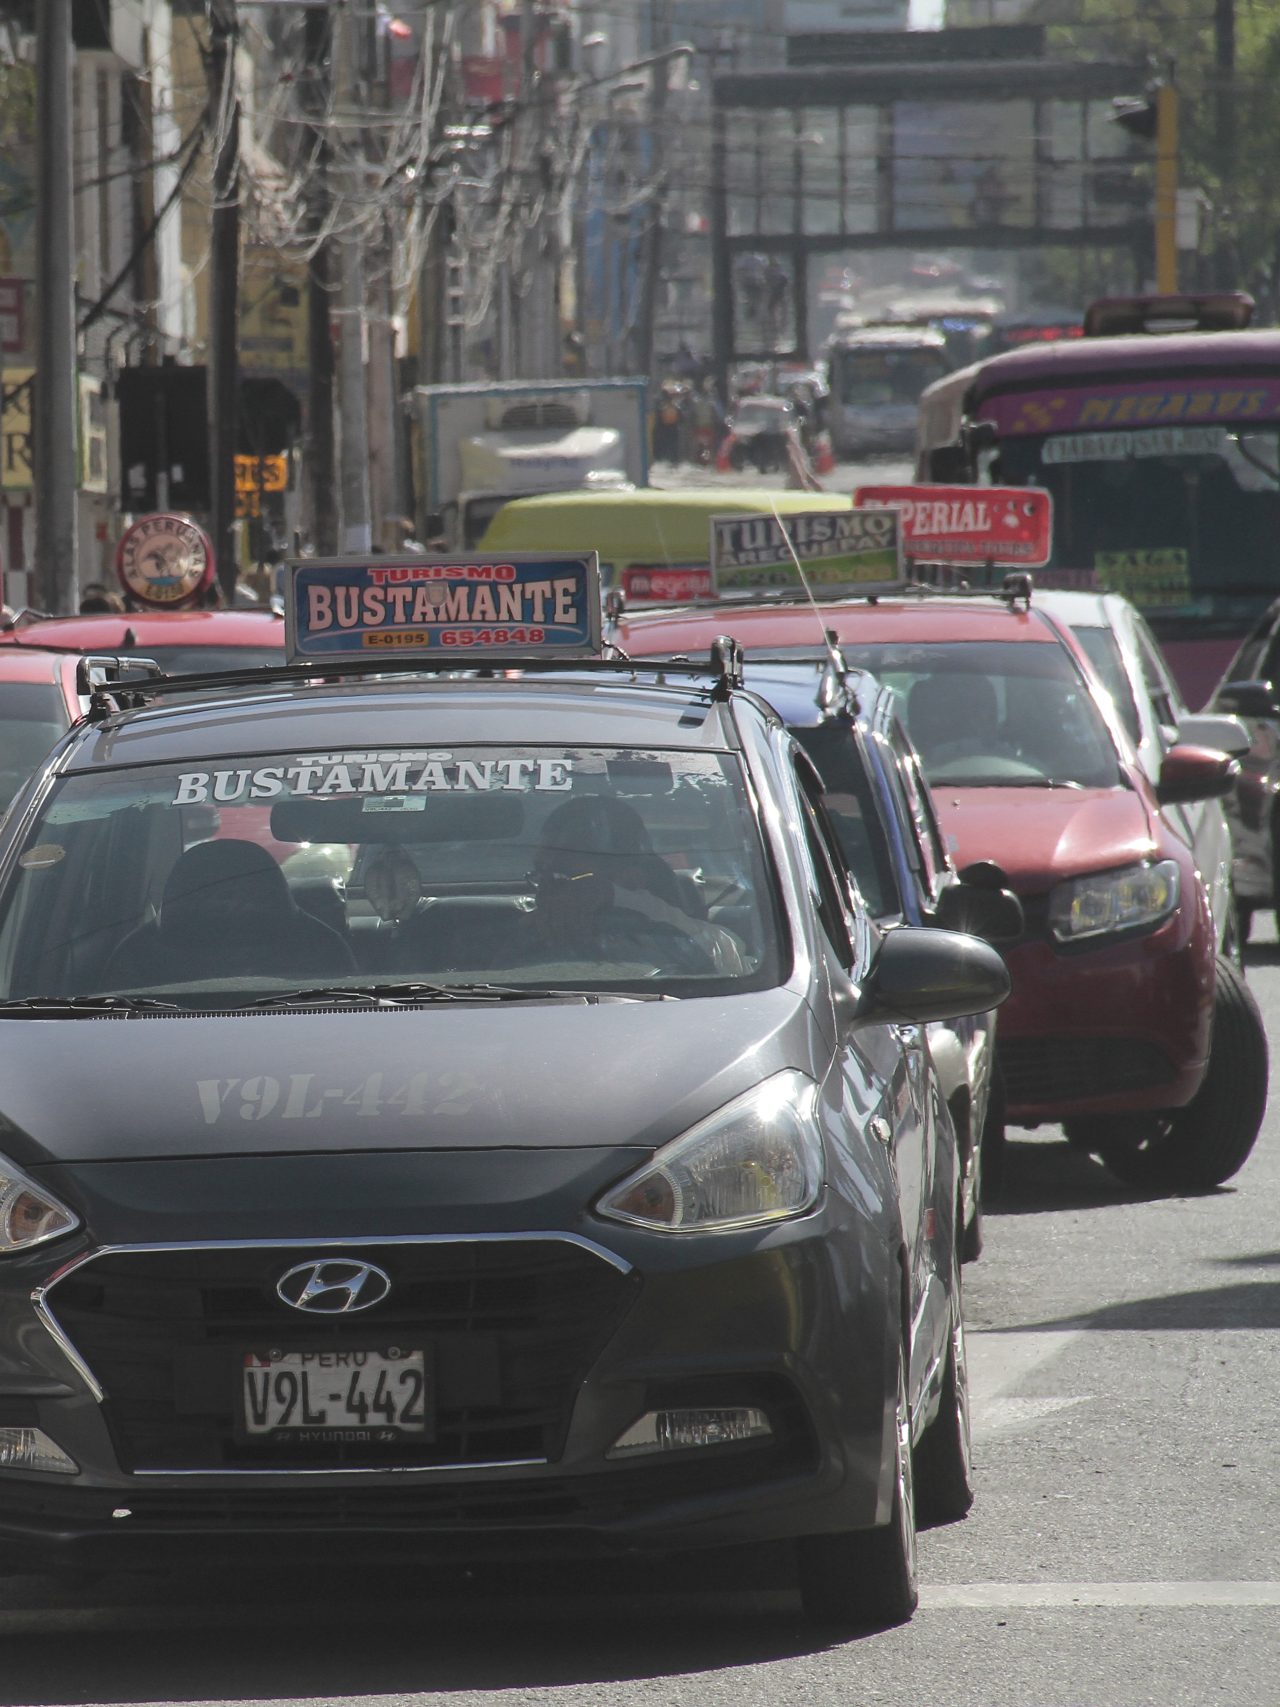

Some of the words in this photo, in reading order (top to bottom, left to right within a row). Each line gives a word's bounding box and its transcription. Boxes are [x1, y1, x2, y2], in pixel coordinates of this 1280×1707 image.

[718, 514, 891, 552] TURISMO
[862, 498, 992, 536] PERIAL
[368, 564, 517, 585] TURISMO
[306, 578, 577, 631] BUSTAMANTE
[368, 633, 425, 645] E-0195
[439, 628, 546, 647] 654848
[172, 758, 574, 806] BUSTAMANTE
[196, 1072, 477, 1124] V9L-442
[301, 1352, 368, 1367] PERU
[247, 1368, 424, 1425] V9L-442
[299, 1431, 370, 1441] HYUNDAI
